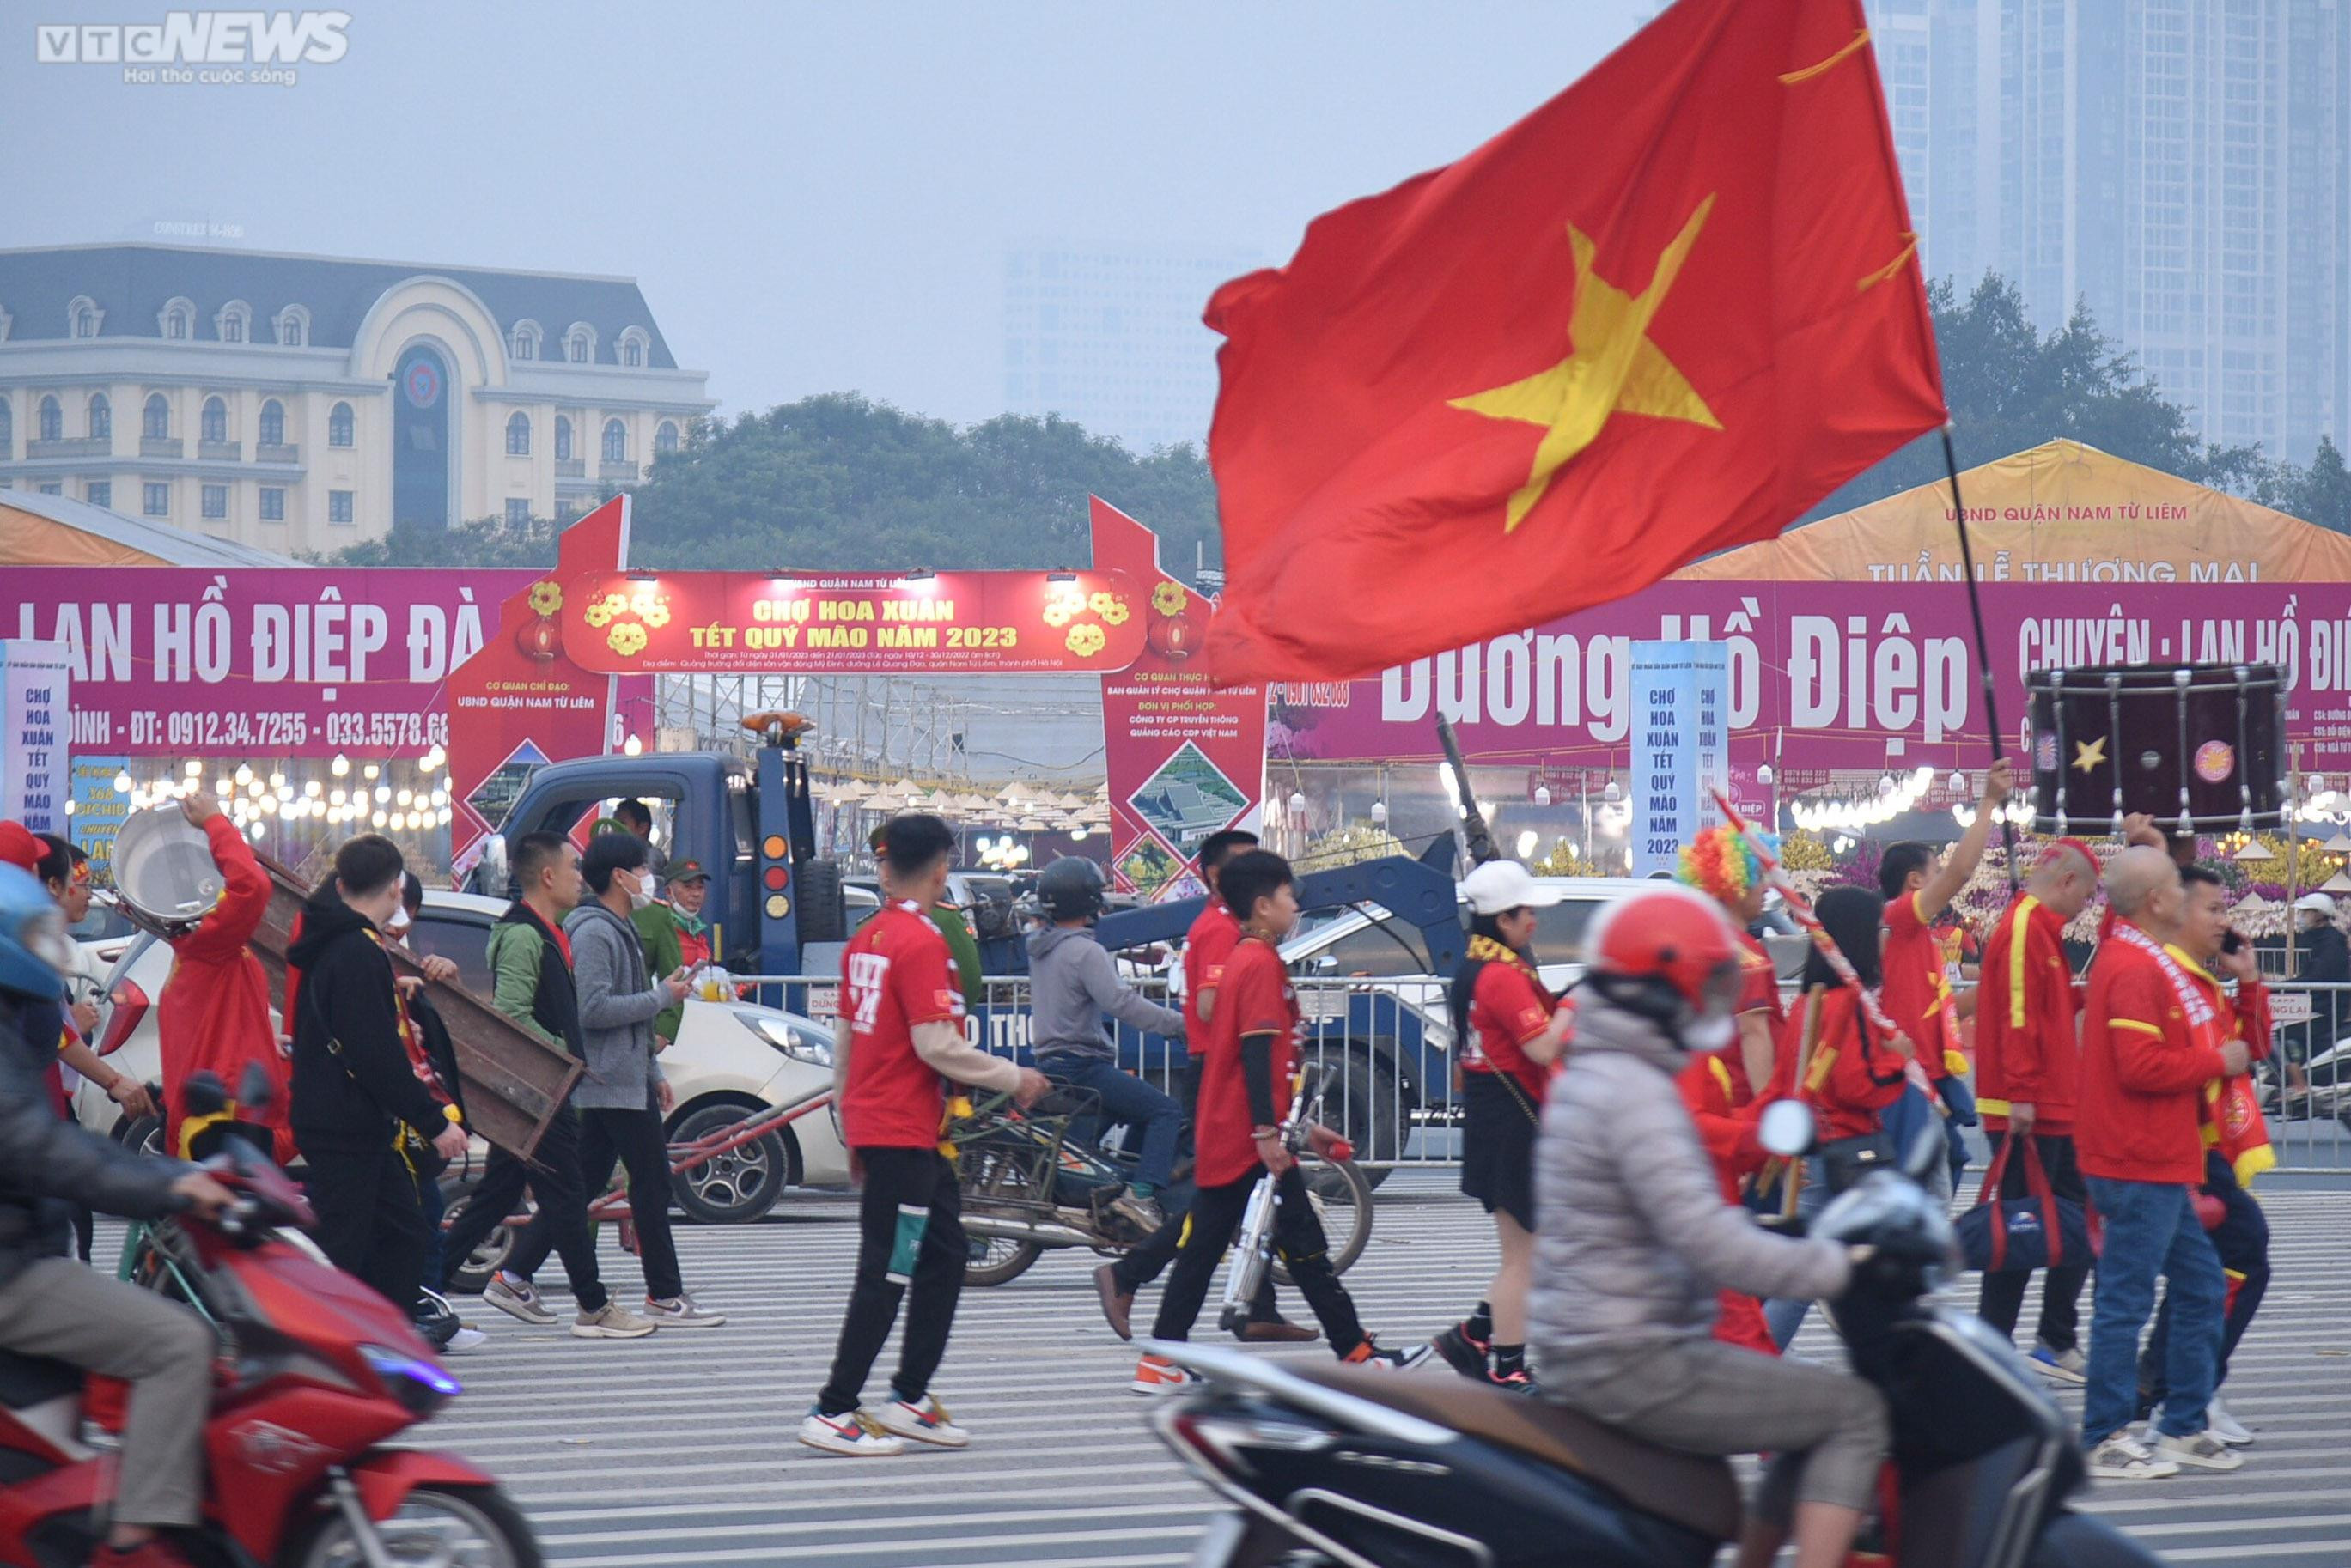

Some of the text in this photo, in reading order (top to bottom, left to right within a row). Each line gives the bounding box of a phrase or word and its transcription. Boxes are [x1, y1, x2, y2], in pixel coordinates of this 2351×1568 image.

[2003, 503, 2062, 526] QUẬN
[2067, 506, 2112, 520] NAM
[2117, 501, 2140, 520] TỪ
[2147, 502, 2188, 520] LIÊM
[819, 577, 848, 590] QUẬN
[850, 580, 874, 588] NAM
[752, 597, 954, 624] CHỢ HOA XUÂN
[153, 575, 232, 683] HỒ
[250, 586, 388, 702] ĐIỆP
[689, 621, 1018, 650] TẾT QUÝ MÃO NĂM 2023
[502, 682, 528, 691] QUAN
[1107, 686, 1124, 695] BAN
[1788, 612, 1969, 756] Điệp
[26, 686, 52, 708] CHỢ
[457, 694, 595, 710] UBND QUẬN NAM TỪ LIÊM
[1649, 687, 1676, 708] CHỢ
[1700, 688, 1715, 704] CHỢ
[26, 710, 51, 725] HOA
[1129, 714, 1154, 723] CÔNG
[1209, 714, 1239, 723] THÔNG
[1649, 710, 1676, 726] HOA
[1701, 710, 1715, 726] HOA
[130, 711, 162, 744] ĐT:
[167, 710, 307, 745] 0912.34.7255
[22, 728, 54, 746] XUÂN
[1647, 729, 1679, 747] XUÂN
[27, 747, 48, 767] TẾT
[1652, 750, 1673, 769] TẾT
[26, 772, 50, 789] QUÝ
[1651, 774, 1675, 792] QUÝ
[1649, 815, 1677, 833] NĂM
[1647, 838, 1679, 854] 2023
